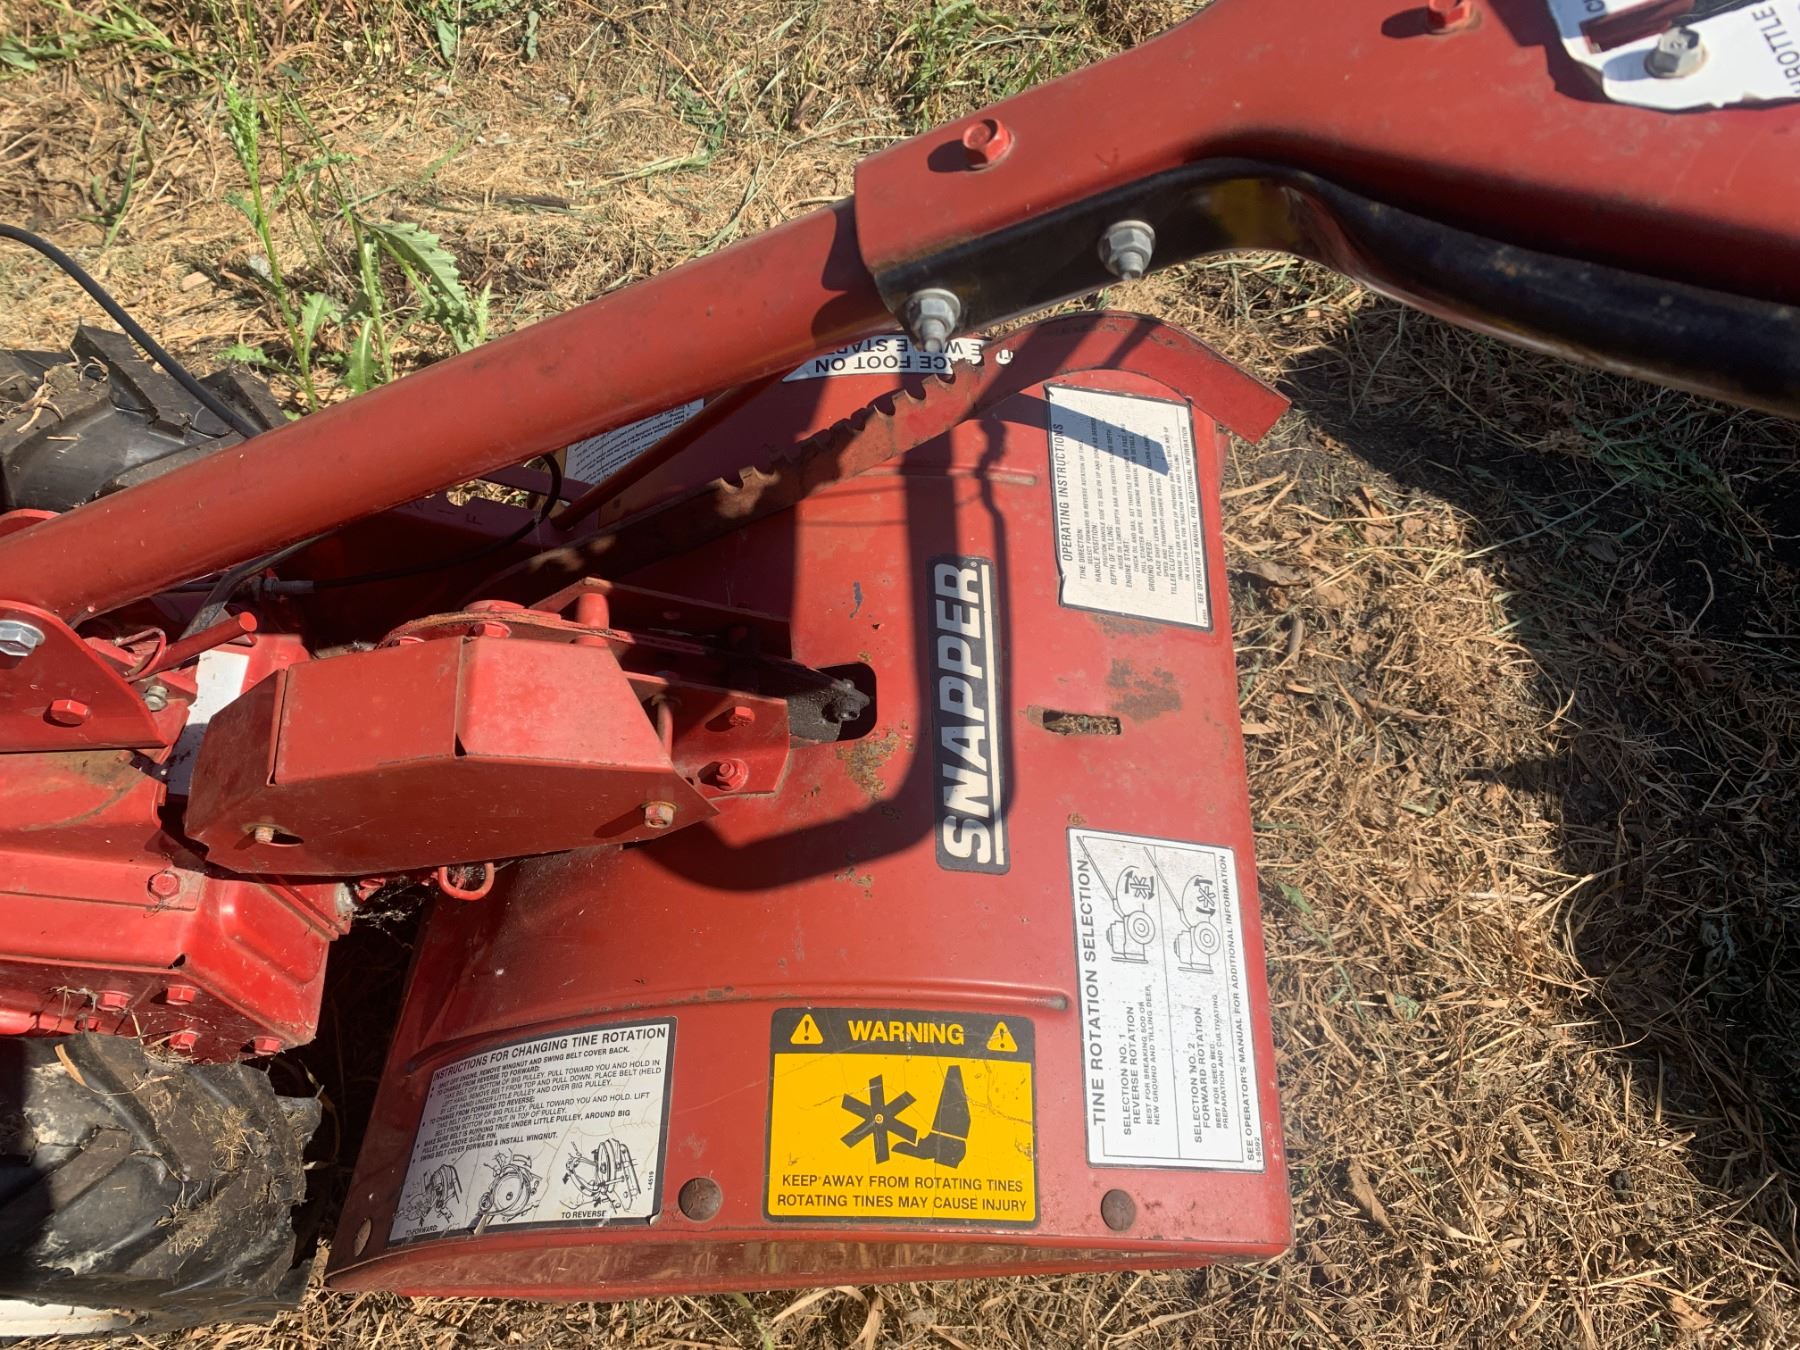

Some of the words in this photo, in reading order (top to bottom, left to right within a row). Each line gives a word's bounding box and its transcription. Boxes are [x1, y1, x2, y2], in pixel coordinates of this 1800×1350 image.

[815, 358, 846, 373] ON
[854, 355, 911, 370] FOOT
[1053, 423, 1068, 497] INSTRUCTIONS
[1181, 426, 1191, 465] INFORMATION
[1185, 468, 1195, 503] ADDITIONAL
[1058, 501, 1072, 561] OPERATING
[1190, 521, 1199, 547] MANUAL
[1108, 553, 1115, 562] OF
[1193, 550, 1203, 590] OPERATOR'S
[1124, 563, 1132, 587] ENGINE
[1147, 564, 1155, 591] GROUND
[1169, 573, 1177, 595] TILLER
[1218, 855, 1232, 924] INFORMATION
[1078, 859, 1096, 962] SELECTION
[1225, 927, 1239, 988] ADDITIONAL
[1231, 992, 1241, 1013] FOR
[847, 1019, 964, 1044] WARNING
[1084, 970, 1103, 1069] ROTATION
[1146, 1010, 1154, 1041] TILLING
[489, 1049, 510, 1063] FOR
[510, 1038, 568, 1058] CHANGING
[570, 1033, 598, 1048] TINE
[601, 1027, 666, 1043] ROTATION
[1126, 1006, 1137, 1064] ROTATION
[1193, 1007, 1205, 1064] ROTATION
[1234, 1017, 1246, 1062] MANUAL
[528, 1057, 542, 1066] AND
[542, 1053, 564, 1063] SWING
[565, 1051, 582, 1059] BELT
[583, 1047, 607, 1057] COVER
[547, 1068, 563, 1077] PULL
[564, 1064, 594, 1074] TOWARD
[595, 1062, 610, 1070] YOU
[612, 1061, 627, 1069] AND
[629, 1059, 650, 1067] HOLD
[523, 1080, 535, 1089] TOP
[536, 1078, 550, 1086] AND
[551, 1076, 567, 1084] PULL
[594, 1070, 617, 1079] PLACE
[619, 1068, 637, 1076] BELT
[536, 1086, 550, 1094] AND
[551, 1083, 569, 1092] OVER
[571, 1081, 582, 1089] BIG
[1150, 1065, 1159, 1102] GROUND
[528, 1101, 544, 1110] PULL
[545, 1097, 574, 1108] TOWARD
[575, 1096, 590, 1104] YOU
[592, 1094, 607, 1102] AND
[634, 1091, 650, 1099] LIFT
[1090, 1078, 1106, 1125] TINE
[1119, 1067, 1132, 1135] SELECTION
[1130, 1069, 1141, 1123] REVERSE
[1189, 1077, 1203, 1142] SELECTION
[1198, 1068, 1211, 1127] FORWARD
[1238, 1066, 1253, 1135] OPERATOR'S
[483, 1117, 495, 1125] AND
[496, 1115, 507, 1123] PUT
[508, 1113, 515, 1121] IN
[516, 1111, 529, 1119] TOP
[510, 1118, 531, 1128] UNDER
[533, 1116, 554, 1125] LITTLE
[584, 1110, 616, 1119] AROUND
[617, 1109, 631, 1117] BIG
[499, 1135, 524, 1145] INSTALL
[1245, 1139, 1255, 1160] SEE
[782, 1174, 817, 1187] KEEP
[822, 1175, 863, 1188] AWAY
[869, 1176, 909, 1189] FROM
[915, 1177, 981, 1191] ROTATING
[987, 1178, 1023, 1192] TINES
[572, 1210, 606, 1218] REVERSE
[777, 1193, 848, 1207] ROTATING
[852, 1195, 893, 1208] TINES
[898, 1196, 927, 1209] MAY
[934, 1197, 977, 1210] CAUSE
[982, 1198, 1026, 1211] INJURY
